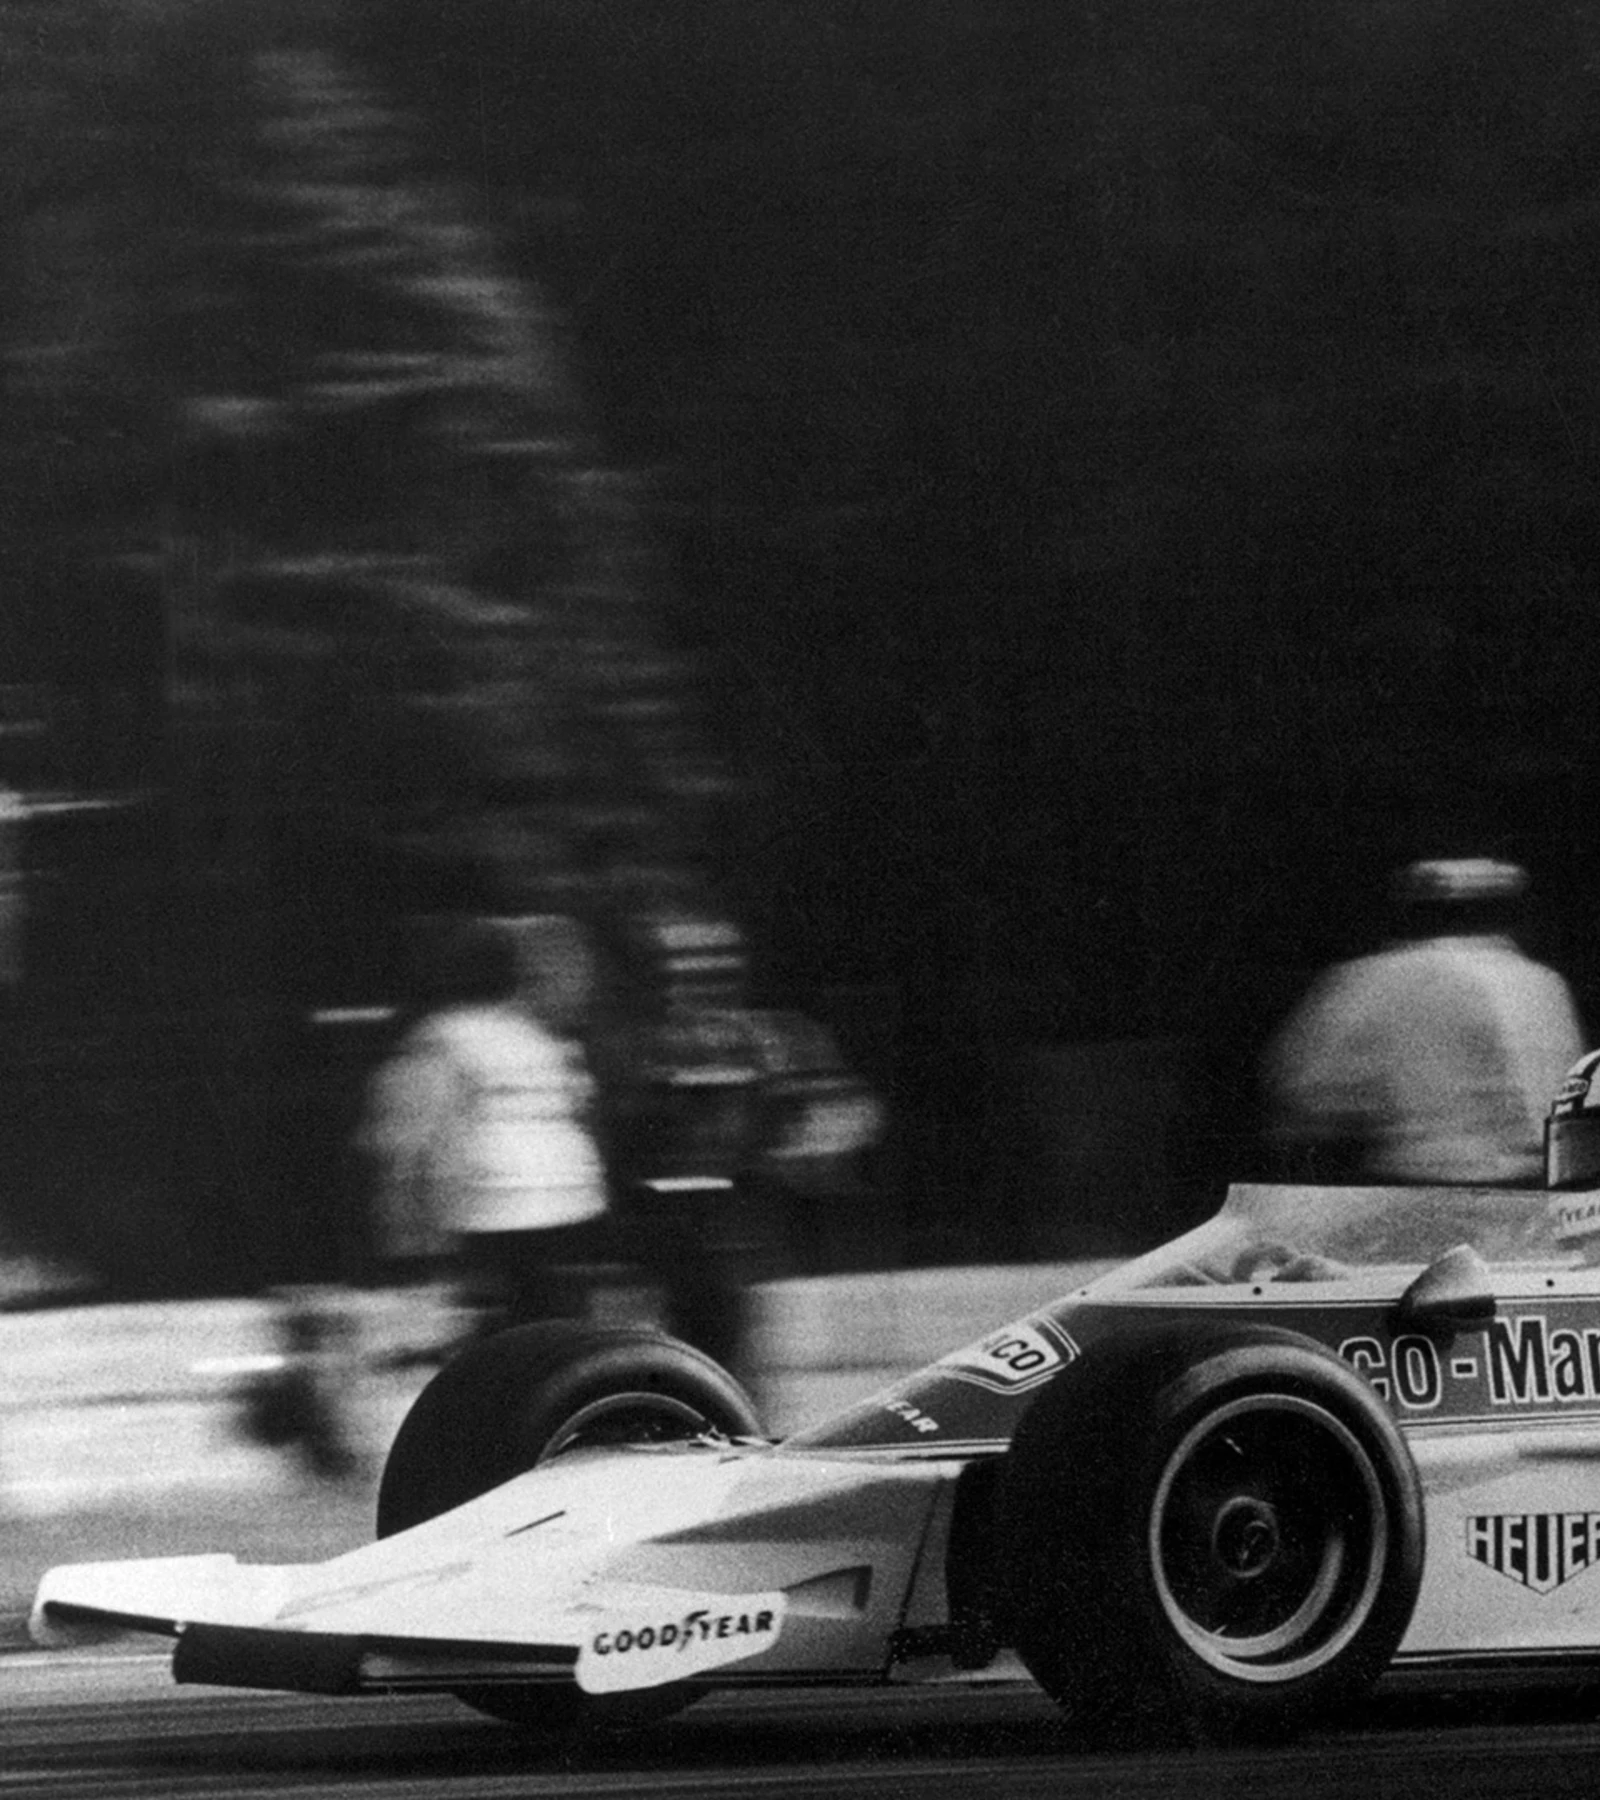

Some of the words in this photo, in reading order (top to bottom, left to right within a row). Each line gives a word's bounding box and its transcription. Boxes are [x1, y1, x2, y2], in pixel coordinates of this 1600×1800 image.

[984, 1334, 1046, 1371] CO
[593, 1624, 678, 1656] GOOD
[698, 1610, 774, 1640] YEAR
